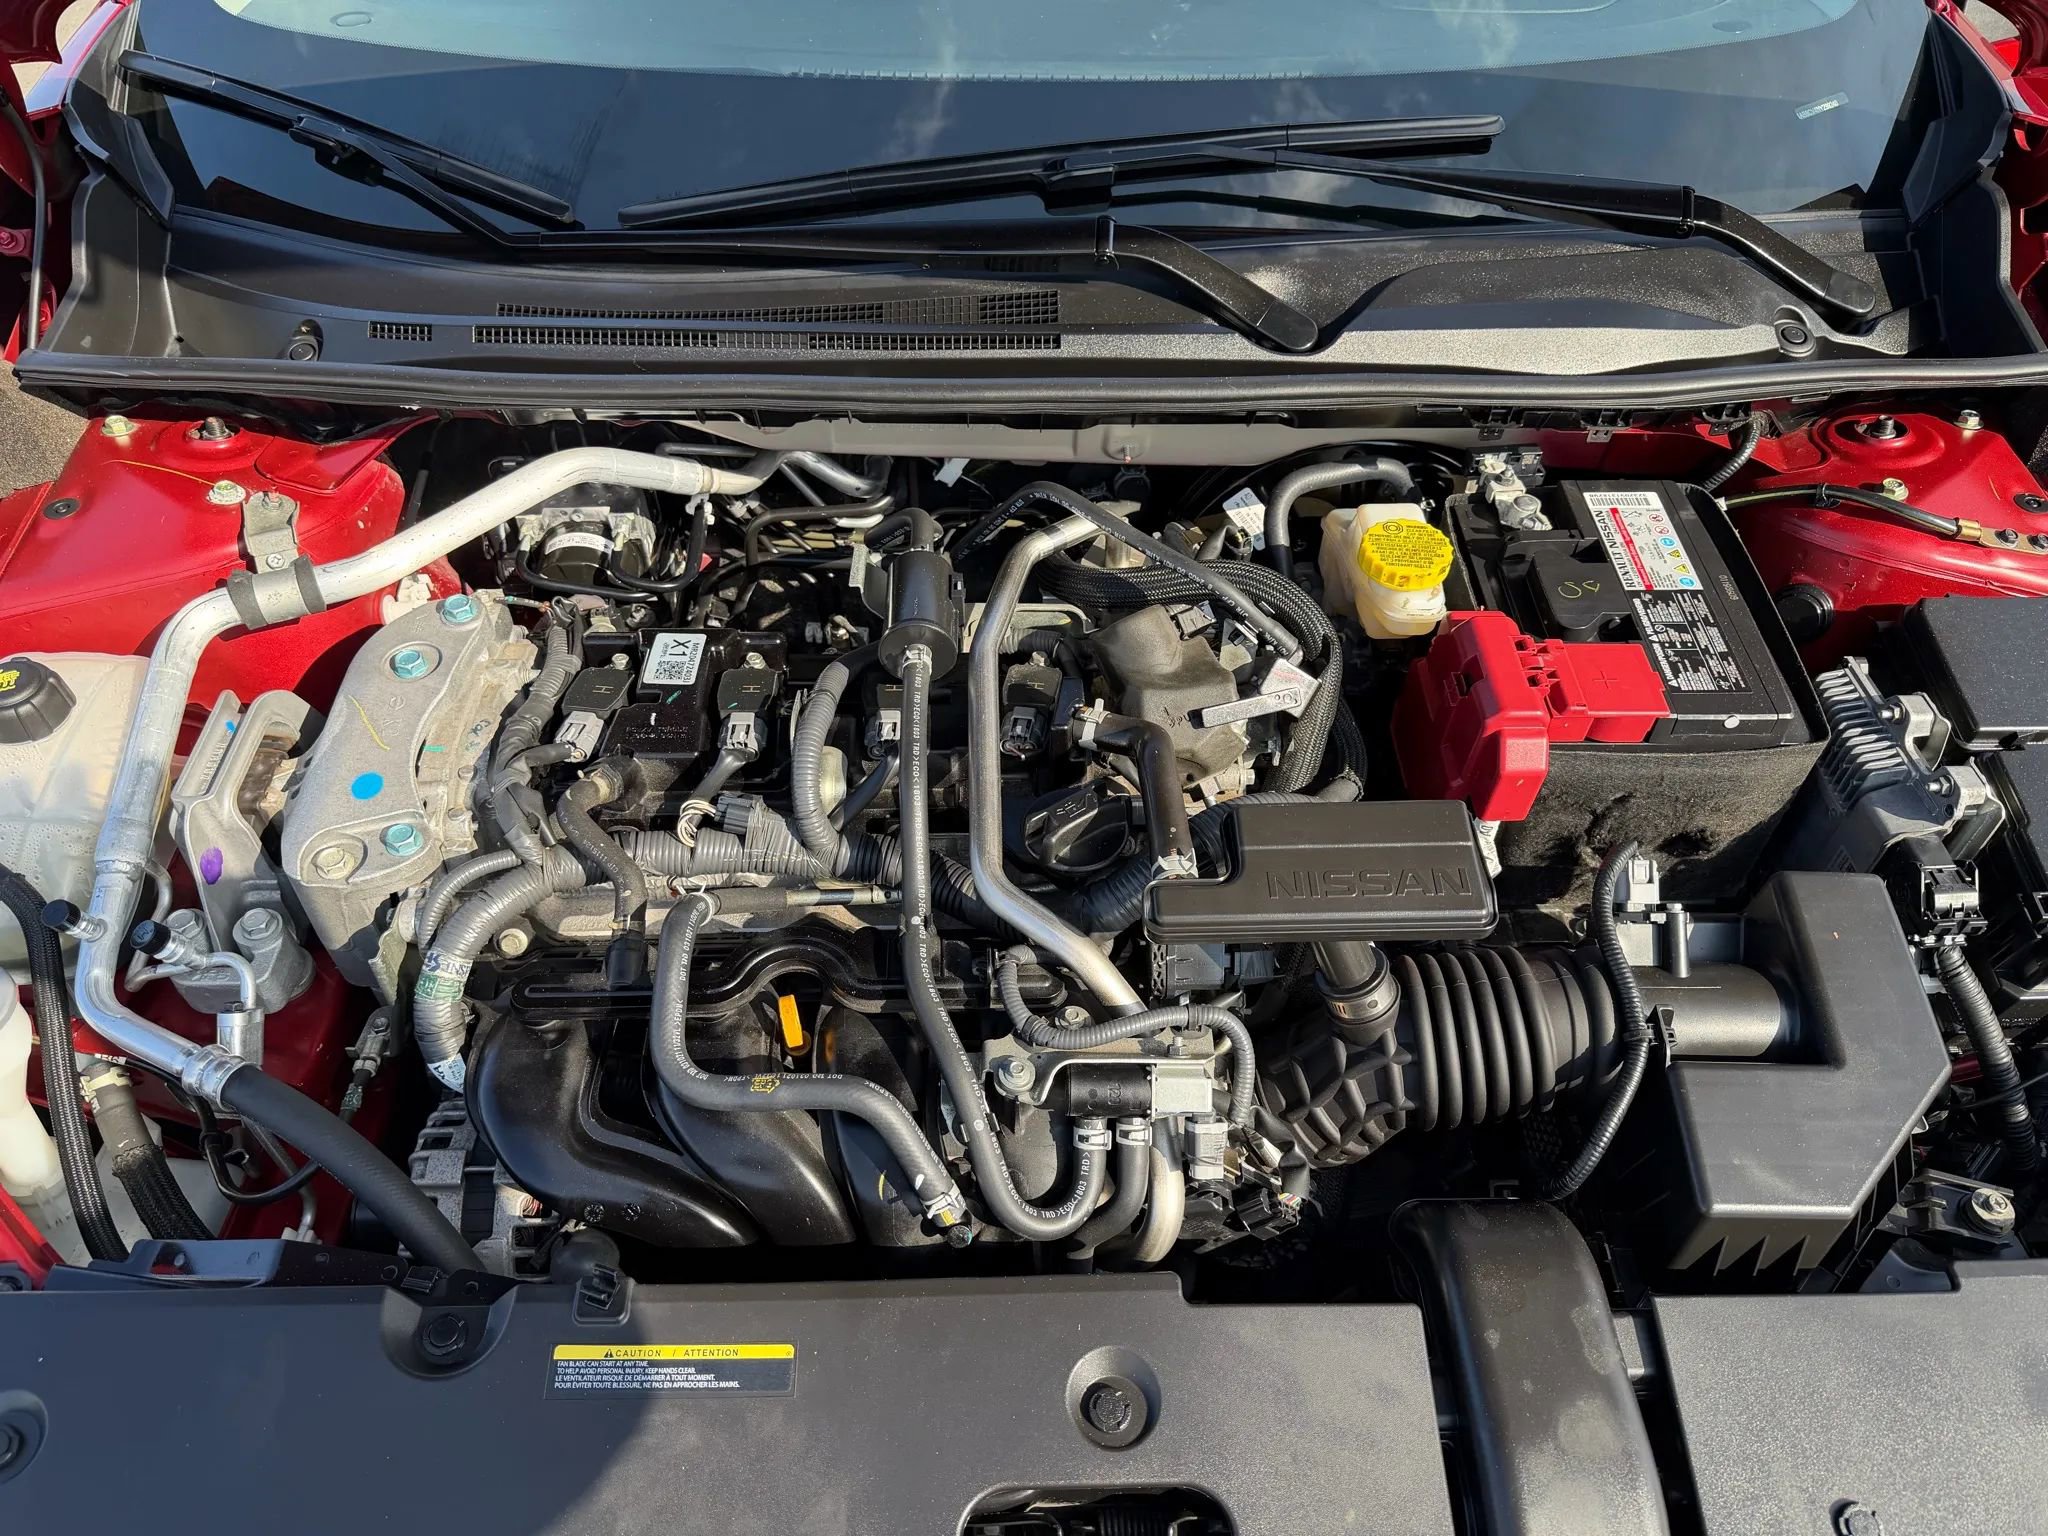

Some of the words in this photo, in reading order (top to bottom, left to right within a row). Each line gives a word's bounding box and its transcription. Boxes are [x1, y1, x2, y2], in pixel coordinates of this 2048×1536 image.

[1593, 510, 1620, 549] NISSAN
[1612, 552, 1637, 588] RENAULT
[669, 639, 692, 656] X1
[1266, 866, 1473, 900] NISSAN
[615, 1349, 661, 1357] CAUTION
[684, 1349, 739, 1357] ATTENTION
